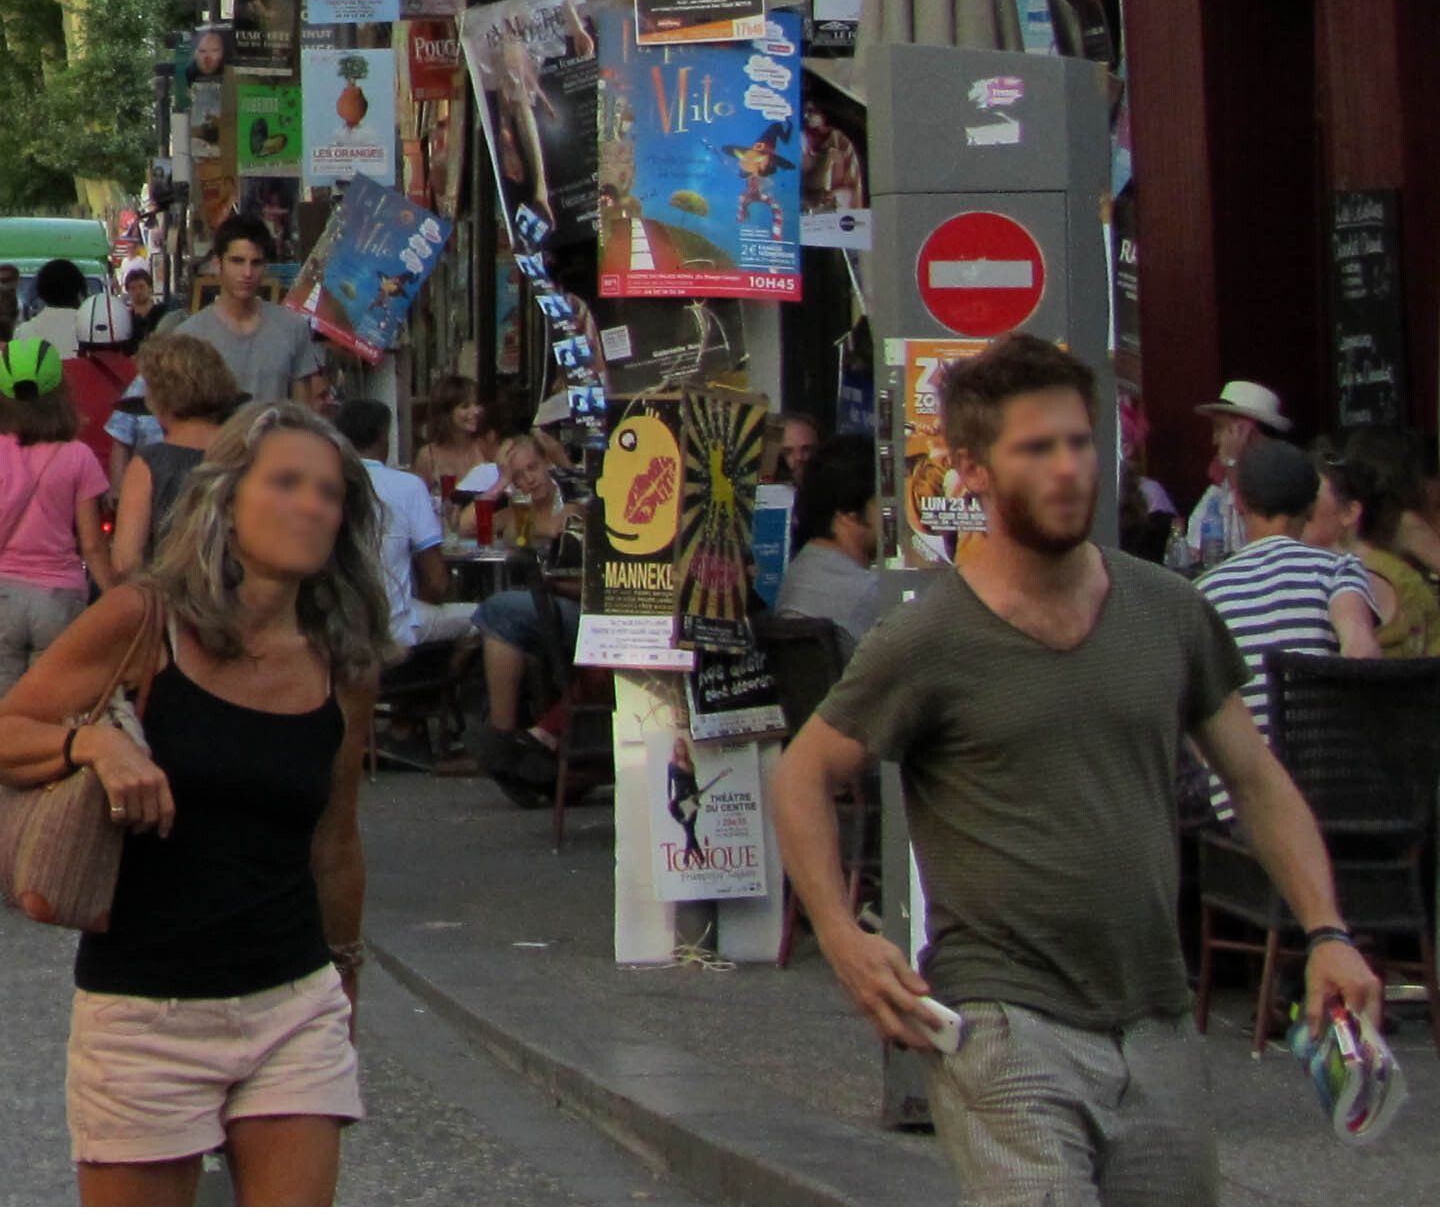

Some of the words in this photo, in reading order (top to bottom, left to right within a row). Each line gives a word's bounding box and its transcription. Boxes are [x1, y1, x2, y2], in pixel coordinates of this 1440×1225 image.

[333, 149, 384, 160] ORANGES
[748, 275, 795, 291] 10H45
[921, 495, 947, 512] LUN
[949, 495, 966, 512] 23
[721, 800, 757, 813] CENTRE
